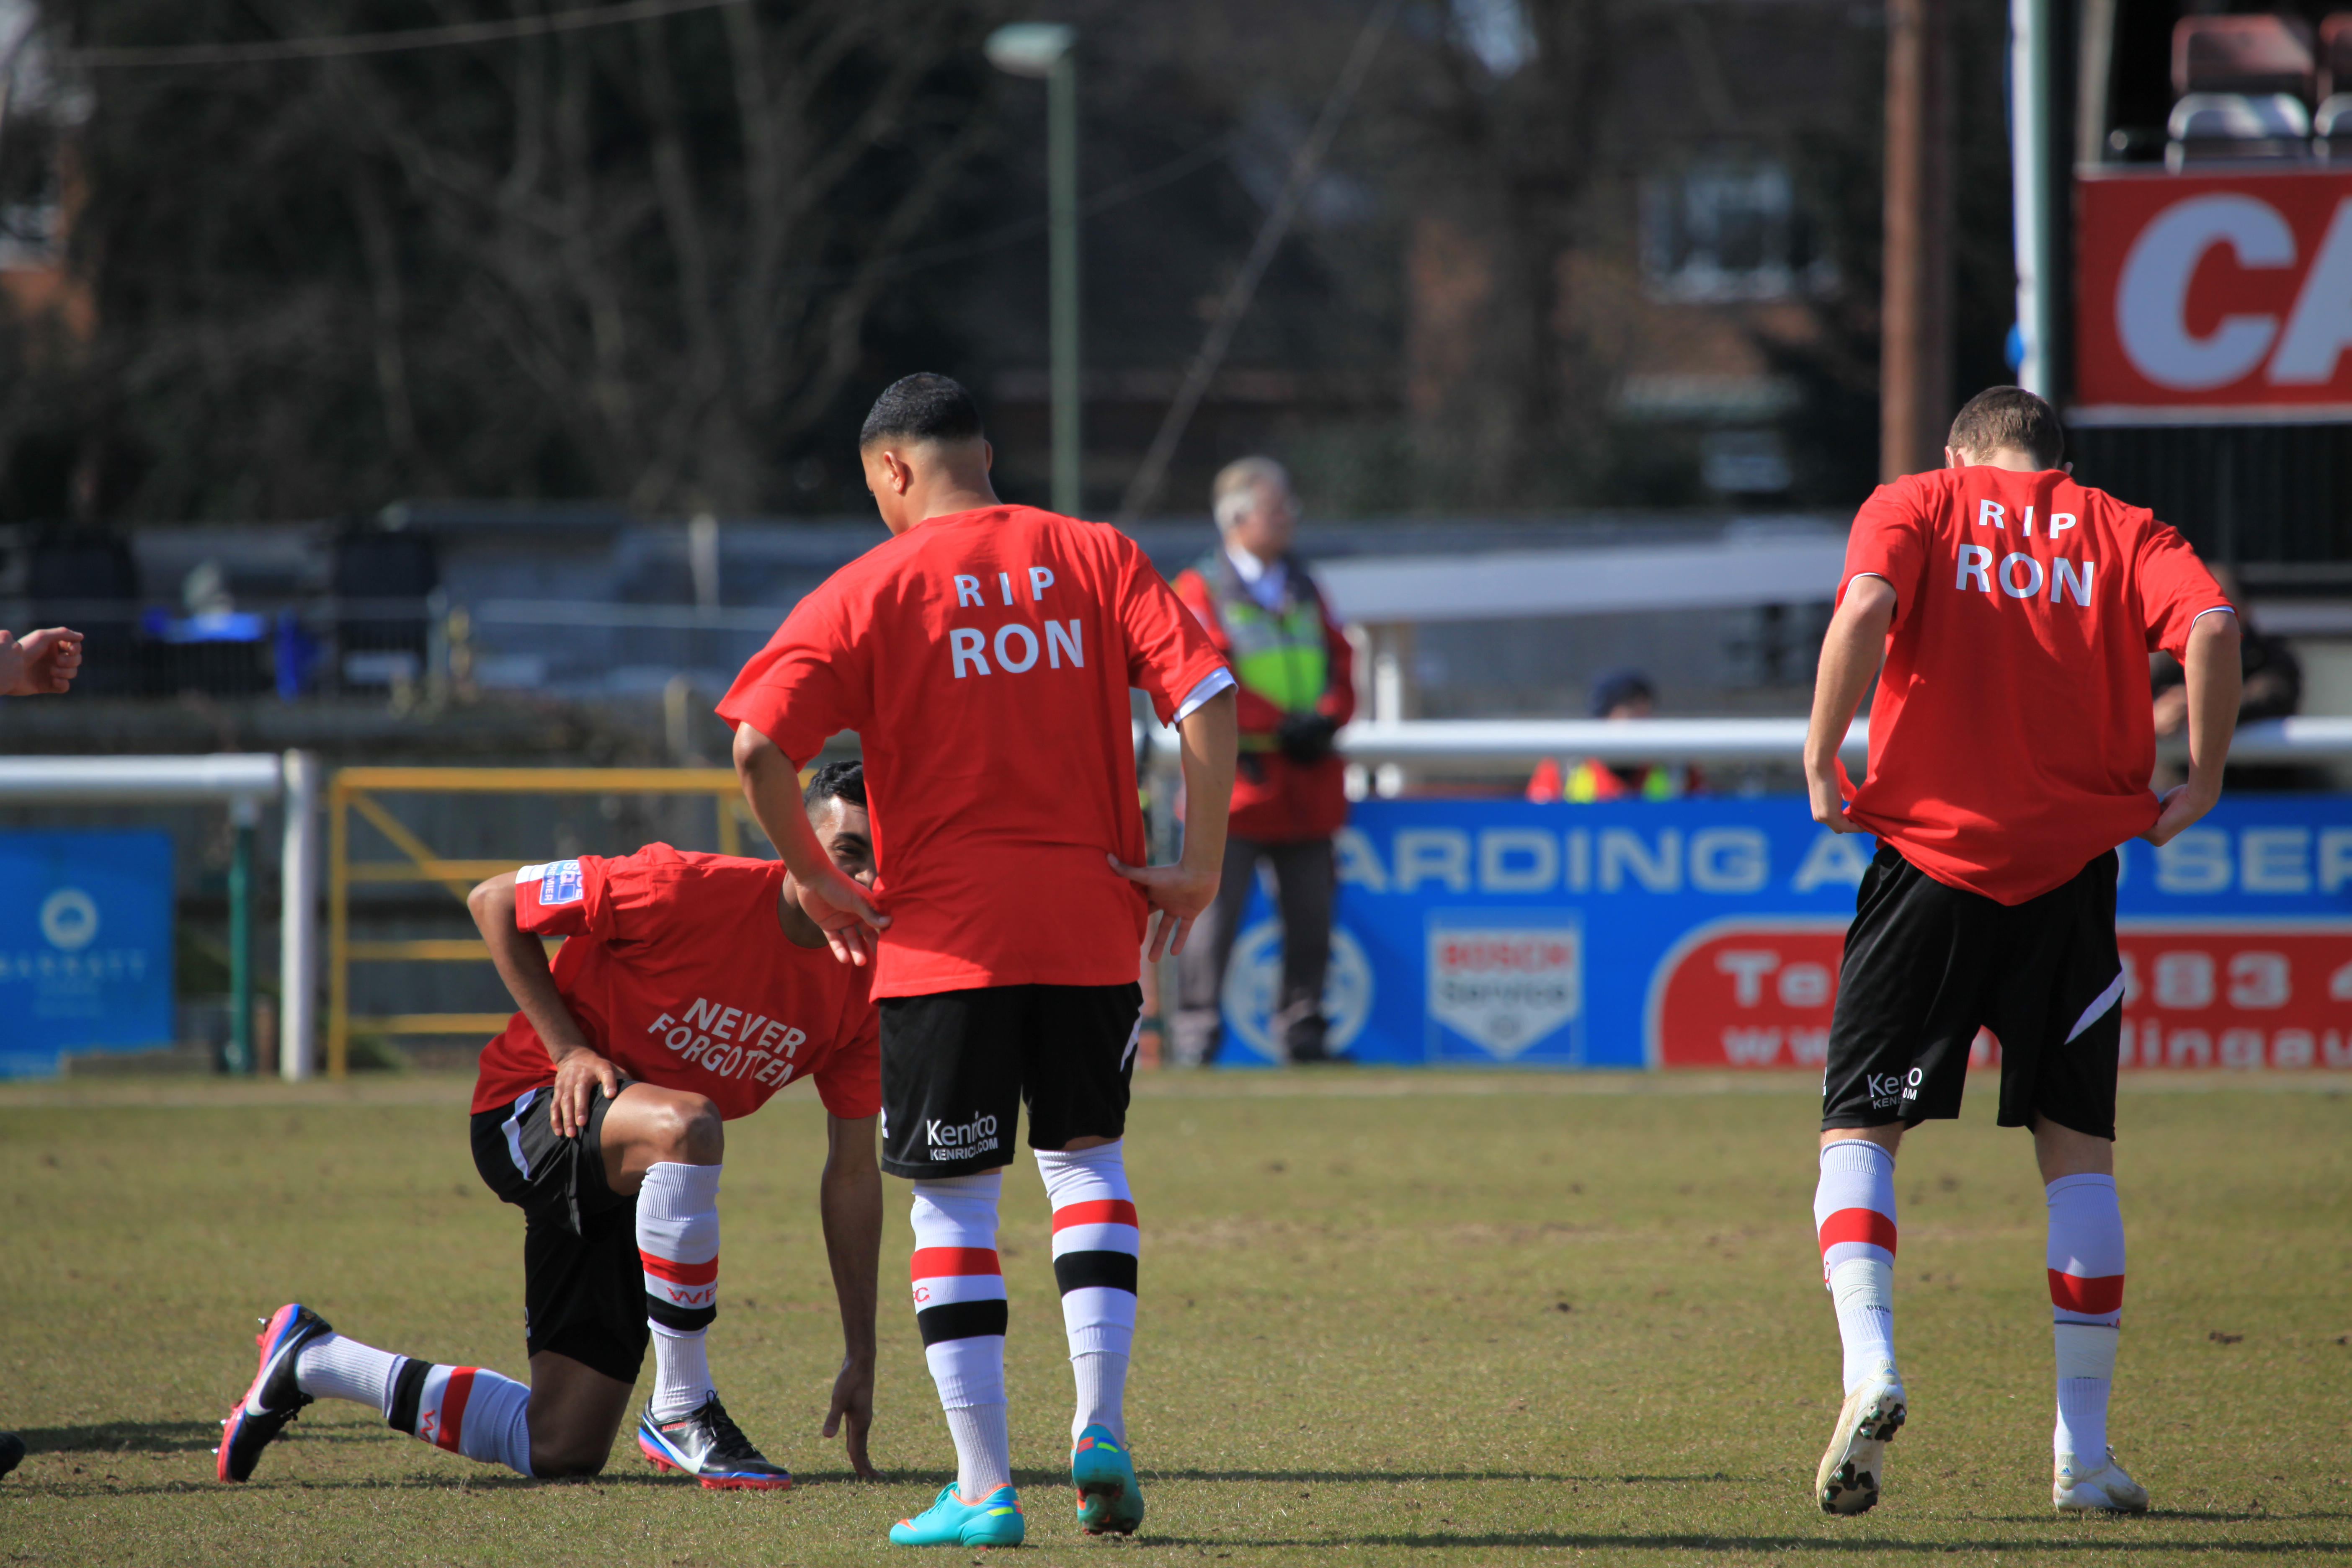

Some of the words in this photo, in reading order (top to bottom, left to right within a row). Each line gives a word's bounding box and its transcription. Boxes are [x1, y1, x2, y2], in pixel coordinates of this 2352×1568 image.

[1978, 499, 2076, 539] RIP
[954, 567, 1055, 607] RIP
[1956, 544, 2094, 606] RON
[949, 619, 1084, 678] RON
[544, 863, 560, 901] PREMIER
[1330, 825, 1769, 895] ARDING
[1715, 950, 1843, 1006] Te
[647, 1013, 794, 1088] FORGOTTEN
[682, 997, 806, 1058] NEVER
